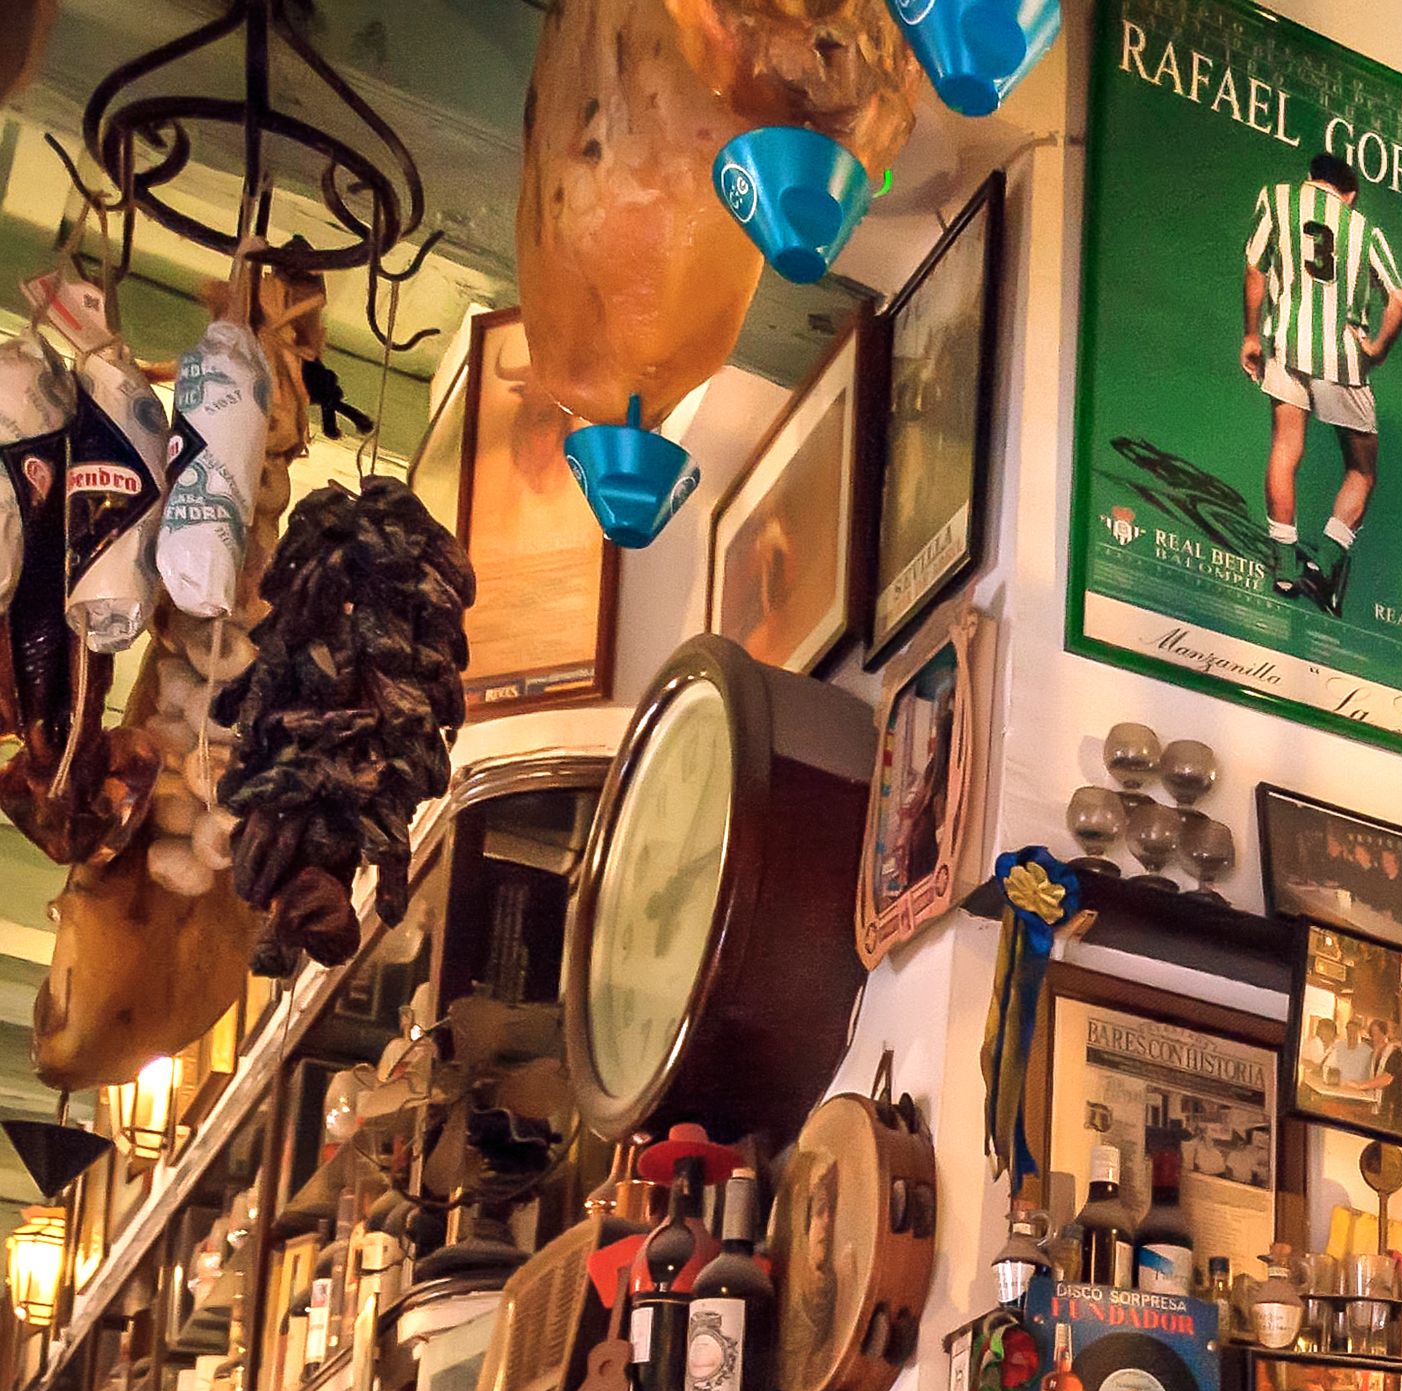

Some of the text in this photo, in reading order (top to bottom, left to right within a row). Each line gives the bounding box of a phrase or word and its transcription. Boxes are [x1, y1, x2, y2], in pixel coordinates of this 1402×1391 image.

[1120, 19, 1300, 148] RAFAEL
[1302, 221, 1338, 283] 3
[1155, 528, 1265, 580] REAL BETIS
[1139, 627, 1283, 686] Manzanilla
[1087, 1019, 1147, 1053] BARES
[1147, 1038, 1184, 1066] CON
[1186, 1048, 1264, 1088] HISTORIA
[1056, 1283, 1187, 1312] DISCO SORPRESA
